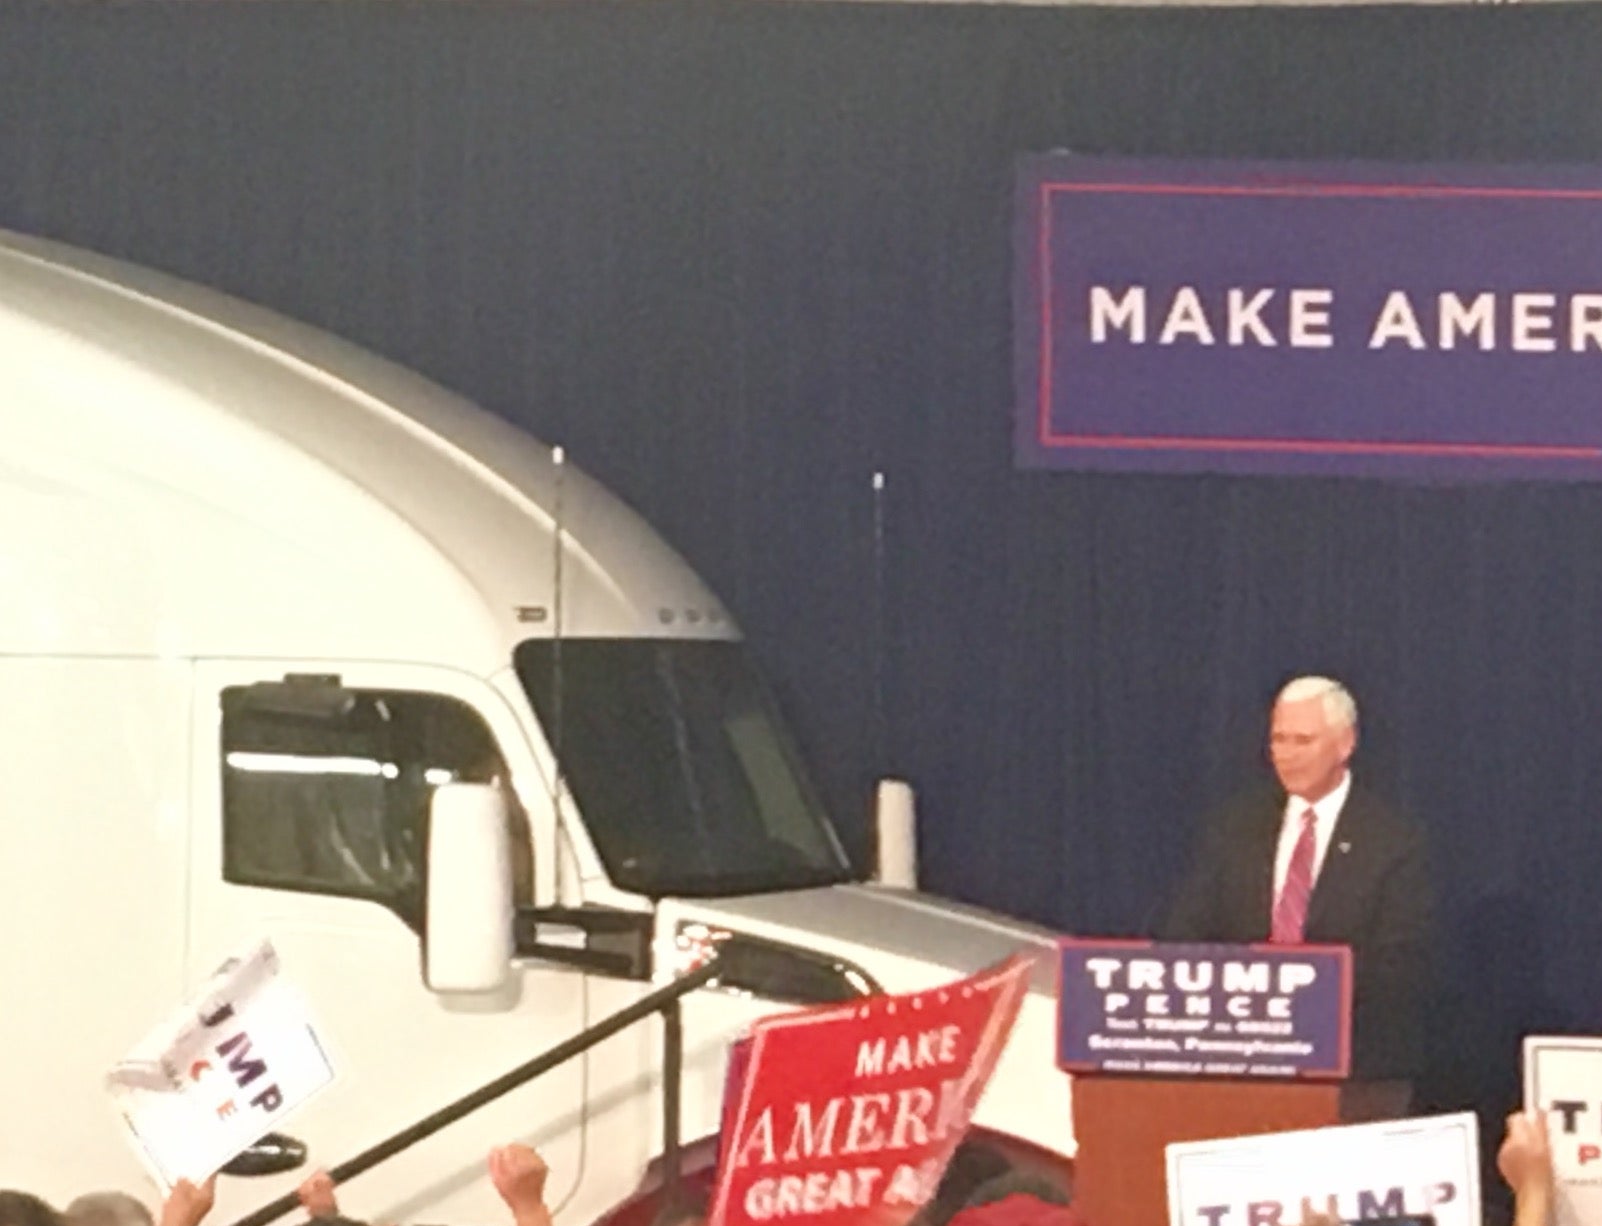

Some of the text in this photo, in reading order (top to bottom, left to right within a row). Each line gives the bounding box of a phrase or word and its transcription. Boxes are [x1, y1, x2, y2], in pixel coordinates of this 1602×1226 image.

[1089, 285, 1334, 349] MAKE
[1086, 957, 1316, 993] TRUMP
[1104, 993, 1292, 1018] PENCE
[855, 1025, 961, 1077] MAKE
[744, 1167, 882, 1222] GREAT
